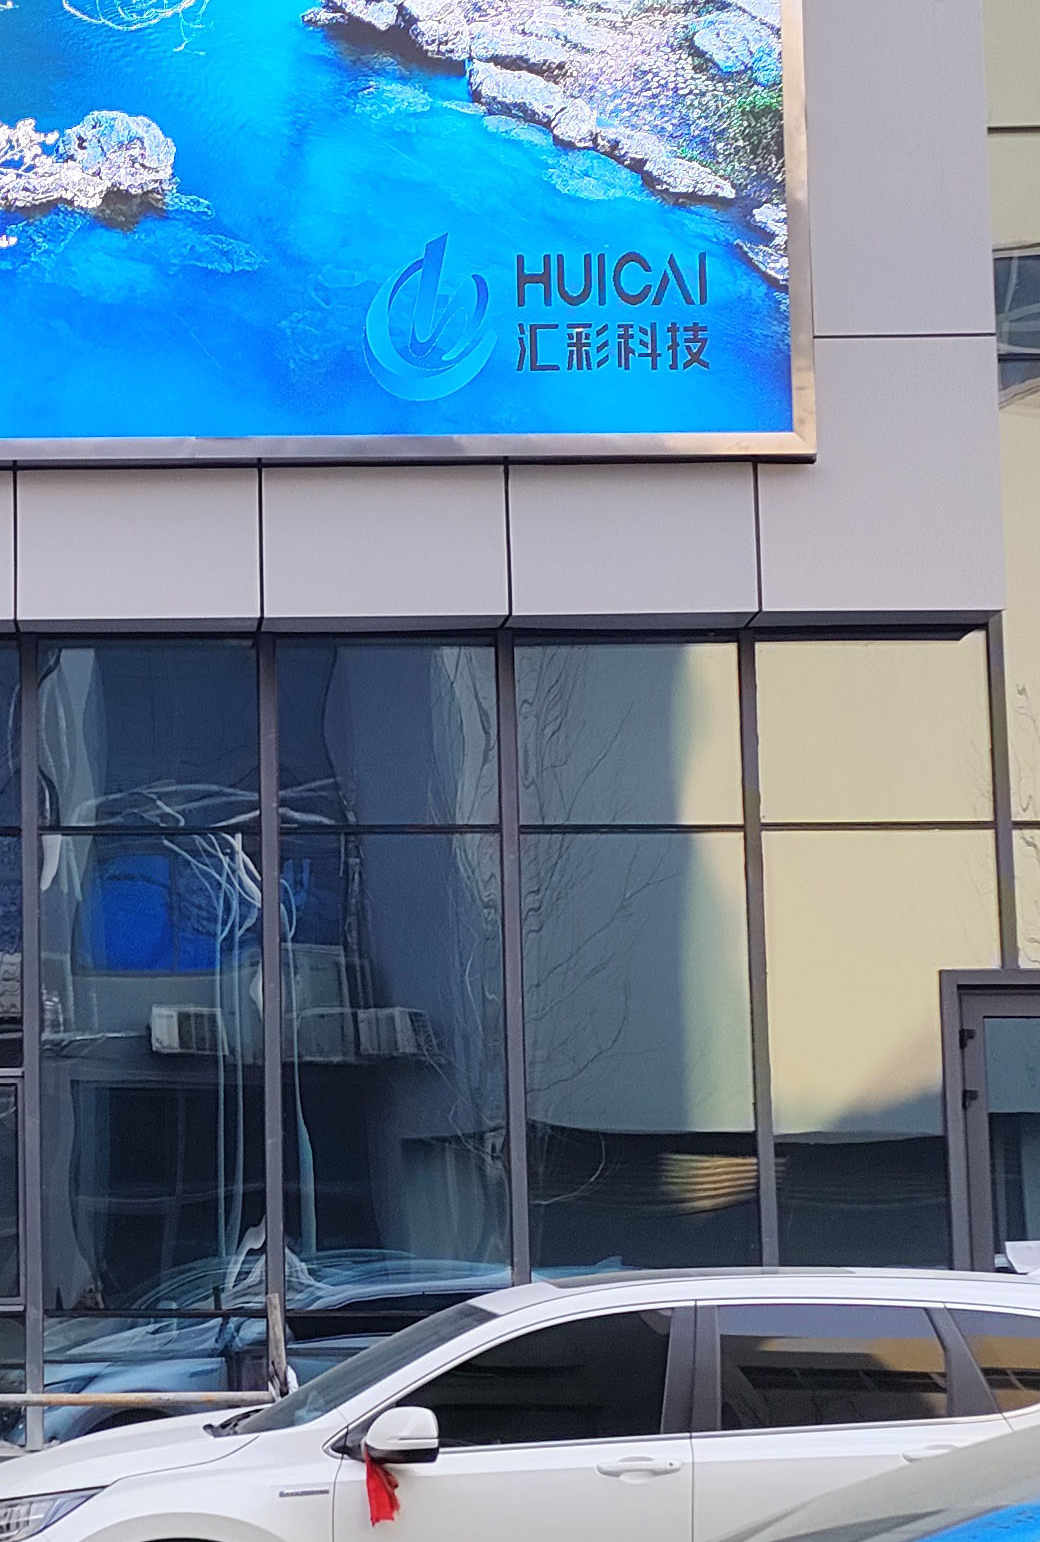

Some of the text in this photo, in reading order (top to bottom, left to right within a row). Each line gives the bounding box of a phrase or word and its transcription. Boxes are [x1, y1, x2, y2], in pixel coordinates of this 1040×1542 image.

[515, 251, 708, 308] HUICAI
[516, 321, 711, 372] 汇彩科技
